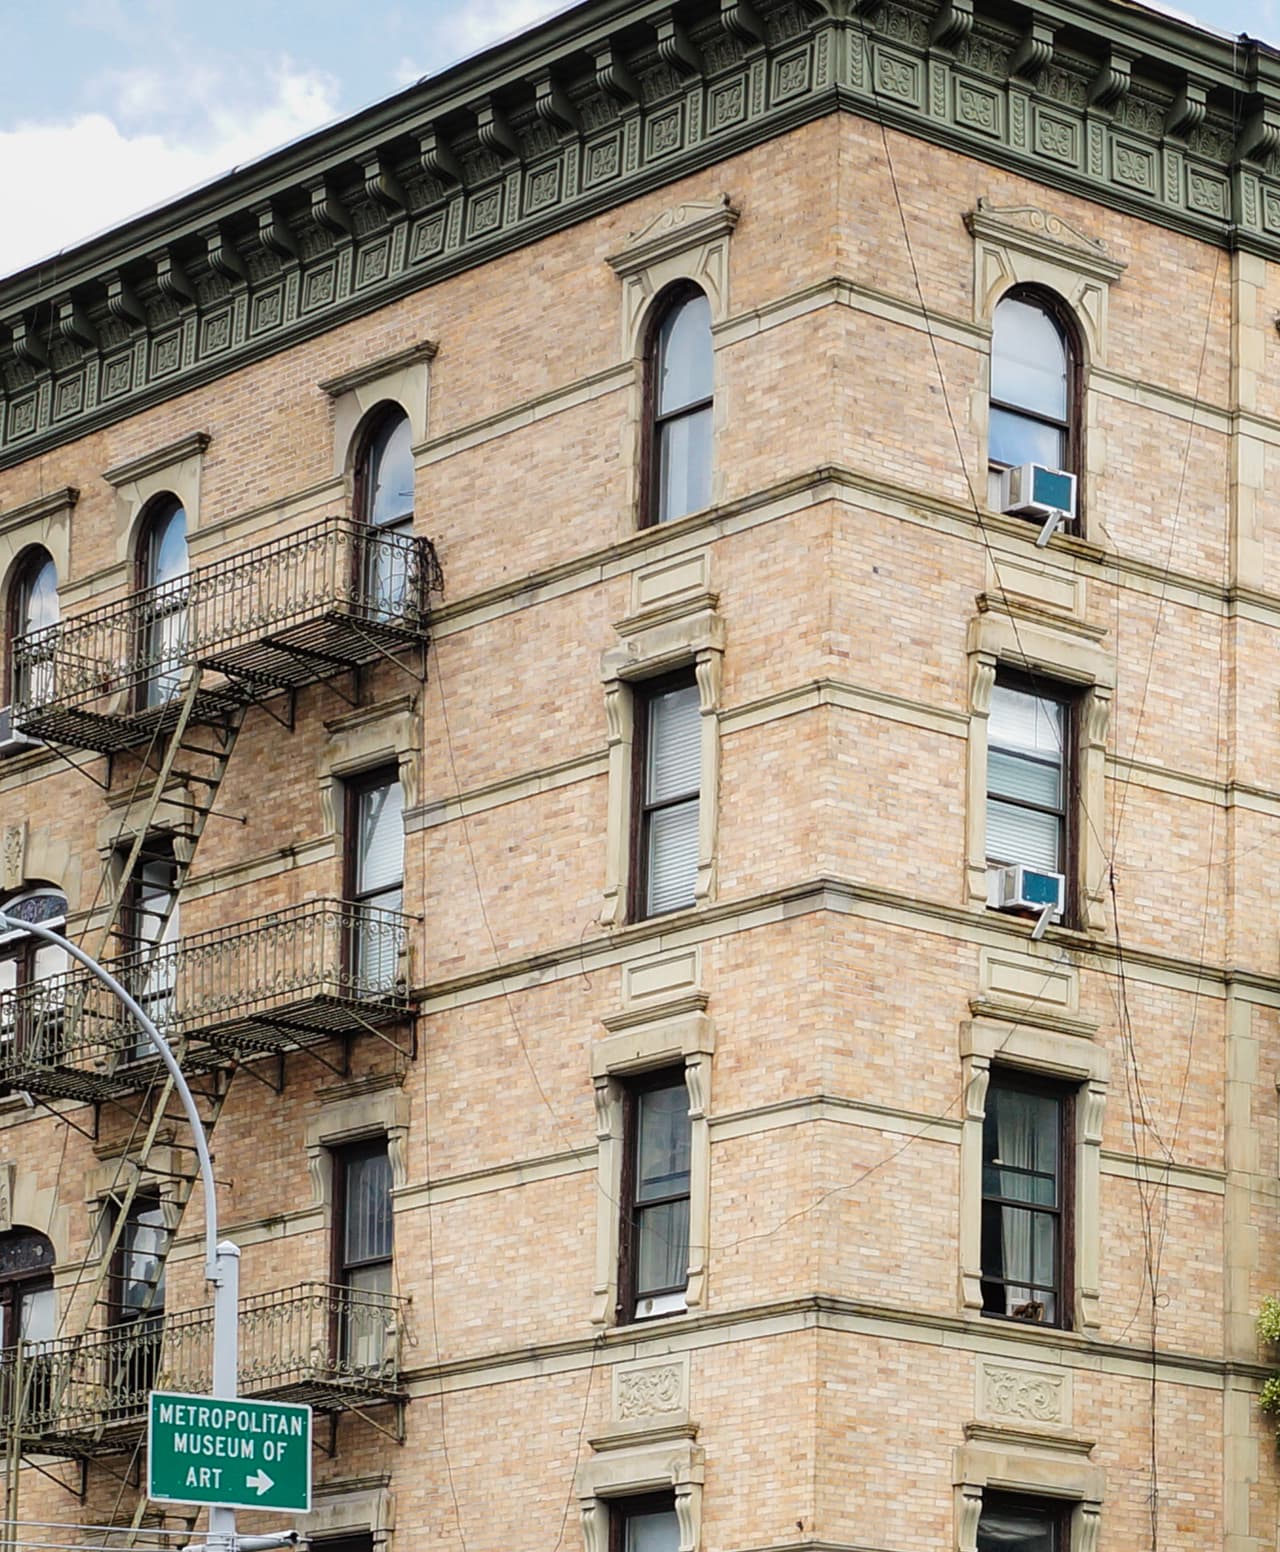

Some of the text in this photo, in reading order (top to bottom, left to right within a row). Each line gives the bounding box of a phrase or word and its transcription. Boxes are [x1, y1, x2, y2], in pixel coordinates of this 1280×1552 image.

[159, 1403, 303, 1436] METROPOLITAN
[174, 1432, 287, 1462] MUSEUM OF
[185, 1466, 222, 1489] ART
